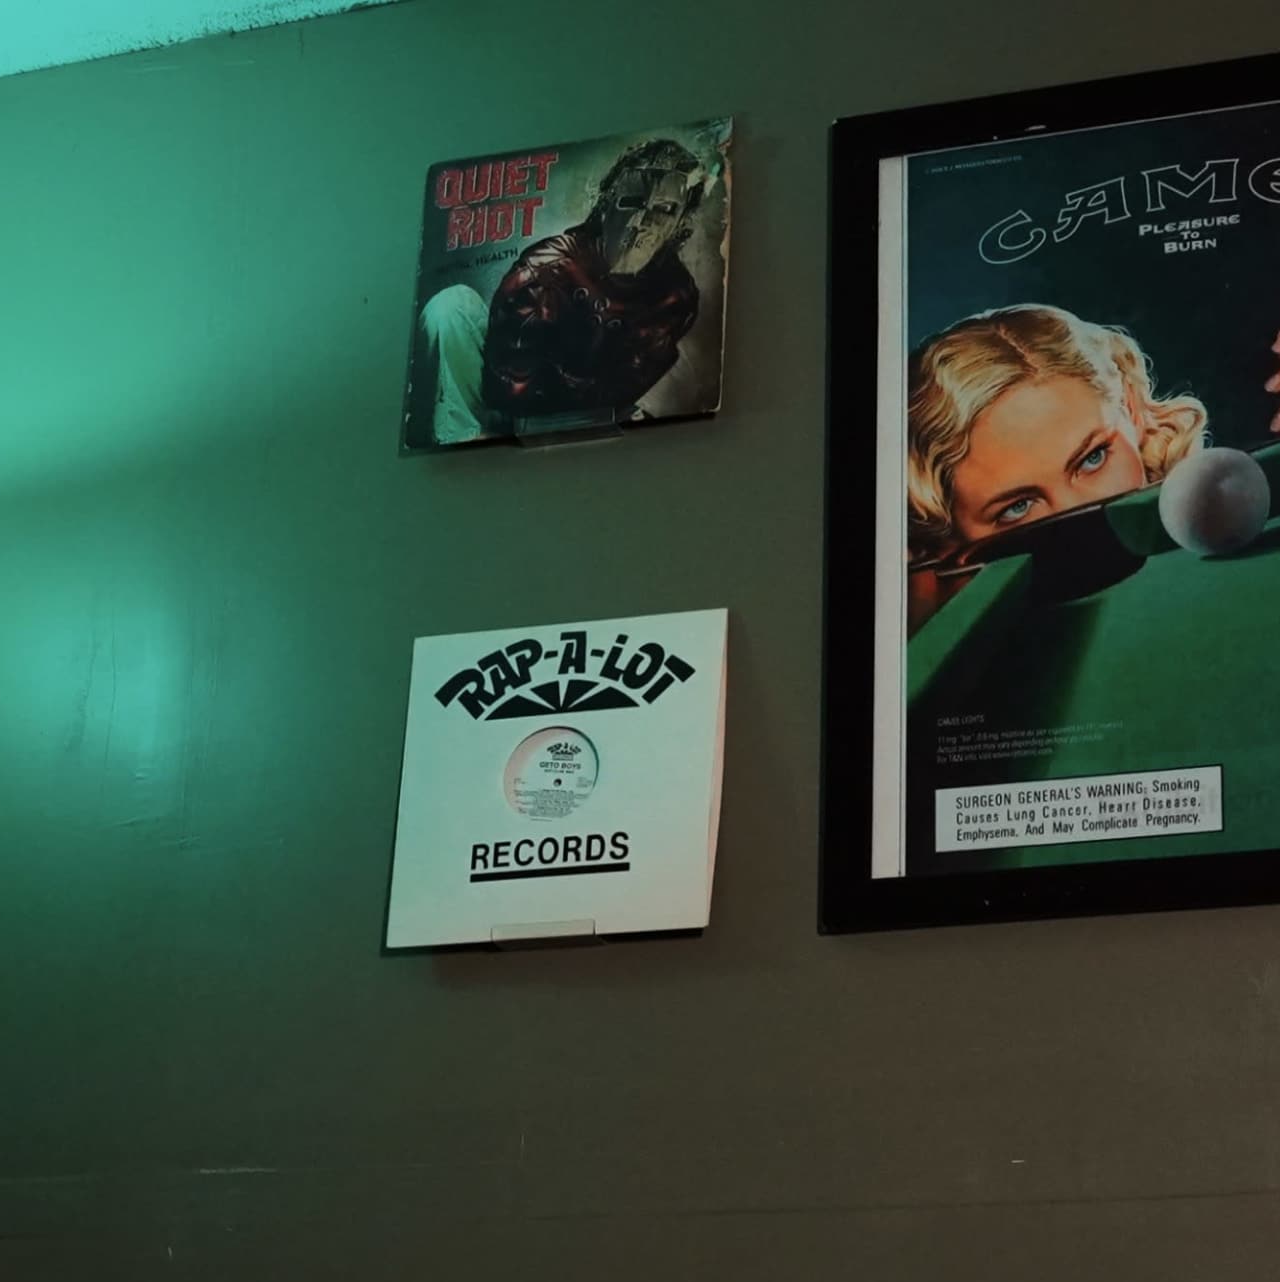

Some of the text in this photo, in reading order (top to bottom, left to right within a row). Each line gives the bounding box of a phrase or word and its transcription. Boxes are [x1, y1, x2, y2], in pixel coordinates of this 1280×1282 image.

[435, 152, 559, 209] QUIET
[446, 197, 544, 251] RIOT
[1138, 214, 1240, 236] PLEASURE
[1163, 238, 1217, 254] BURN
[955, 778, 1200, 809] SURGEON GENERAL'S WARNING: Smoking
[956, 811, 999, 826] Causes
[1006, 806, 1036, 822] Lung
[1098, 799, 1136, 815] Heart
[1025, 822, 1045, 836] And
[1052, 819, 1074, 835] May
[1081, 815, 1138, 833] Complicate
[469, 831, 630, 871] RECORDS
